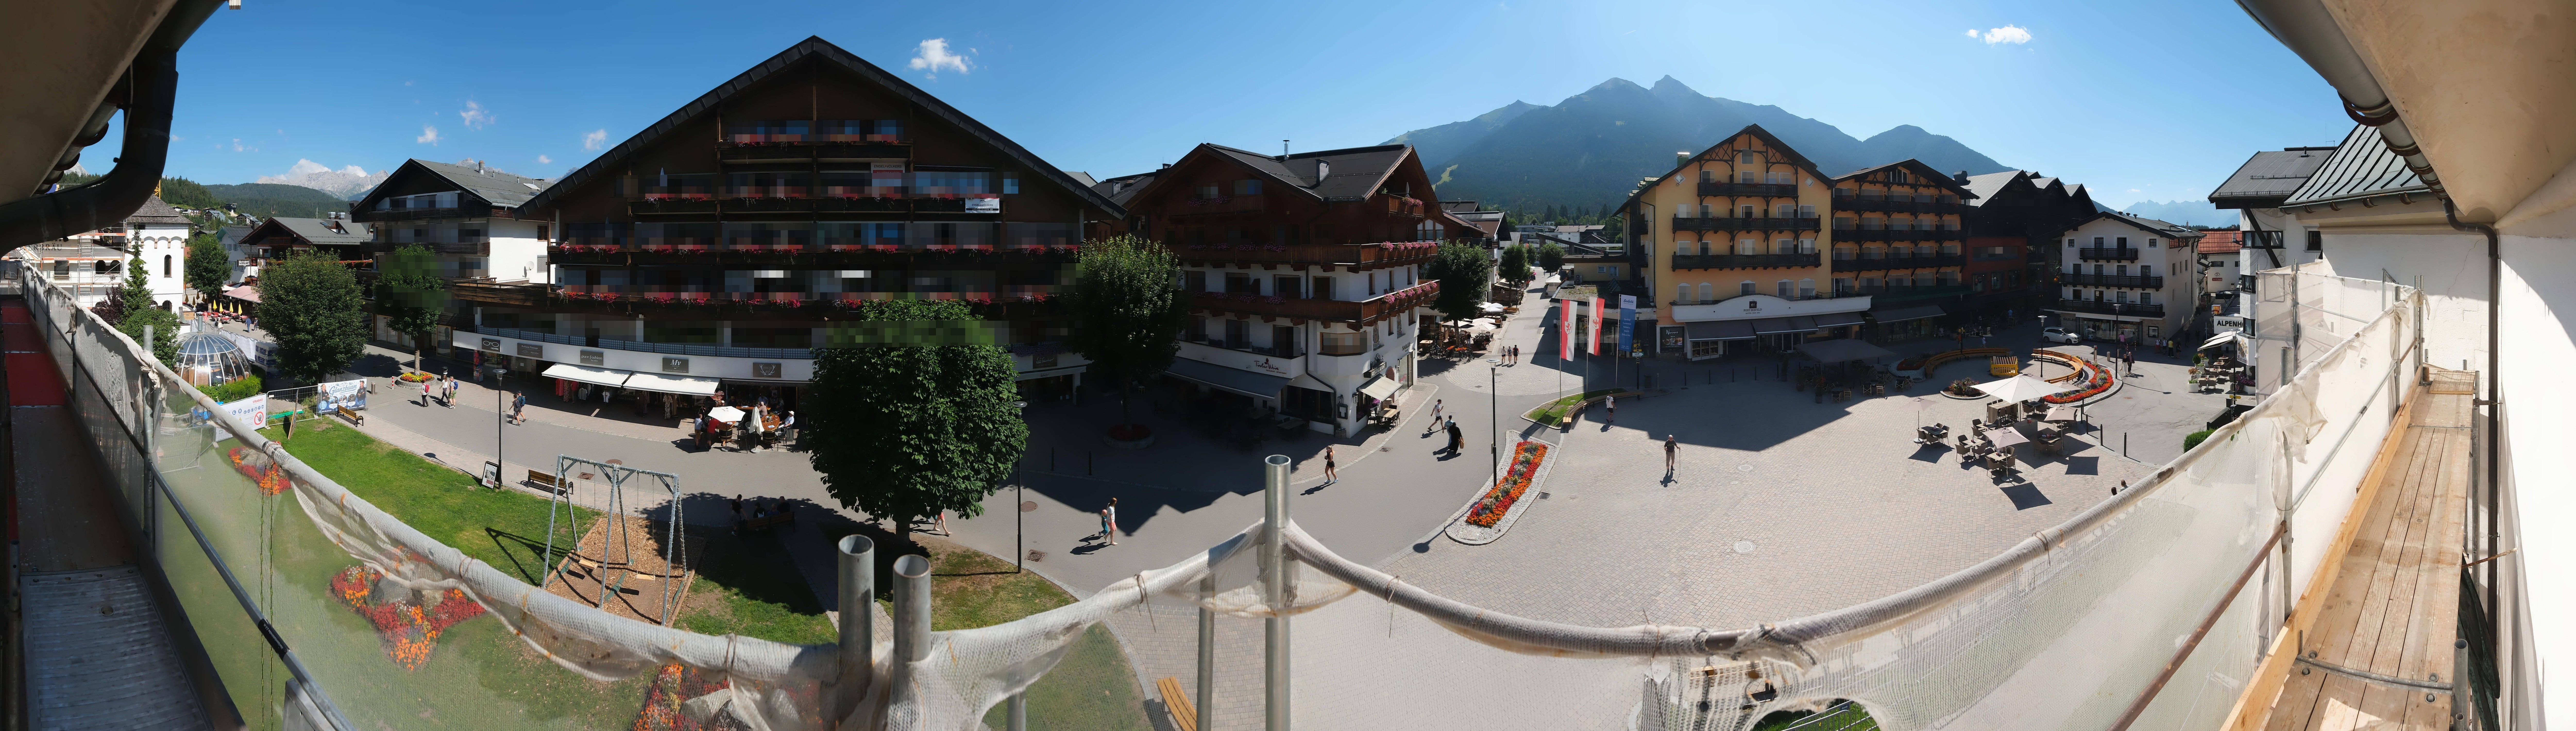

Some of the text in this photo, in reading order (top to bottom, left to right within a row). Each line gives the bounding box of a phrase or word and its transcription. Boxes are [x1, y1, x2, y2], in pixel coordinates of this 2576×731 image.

[1402, 342, 1410, 351] SAILER
[1372, 363, 1386, 376] RESTAURANT
[329, 385, 357, 397] Glanzbuam
